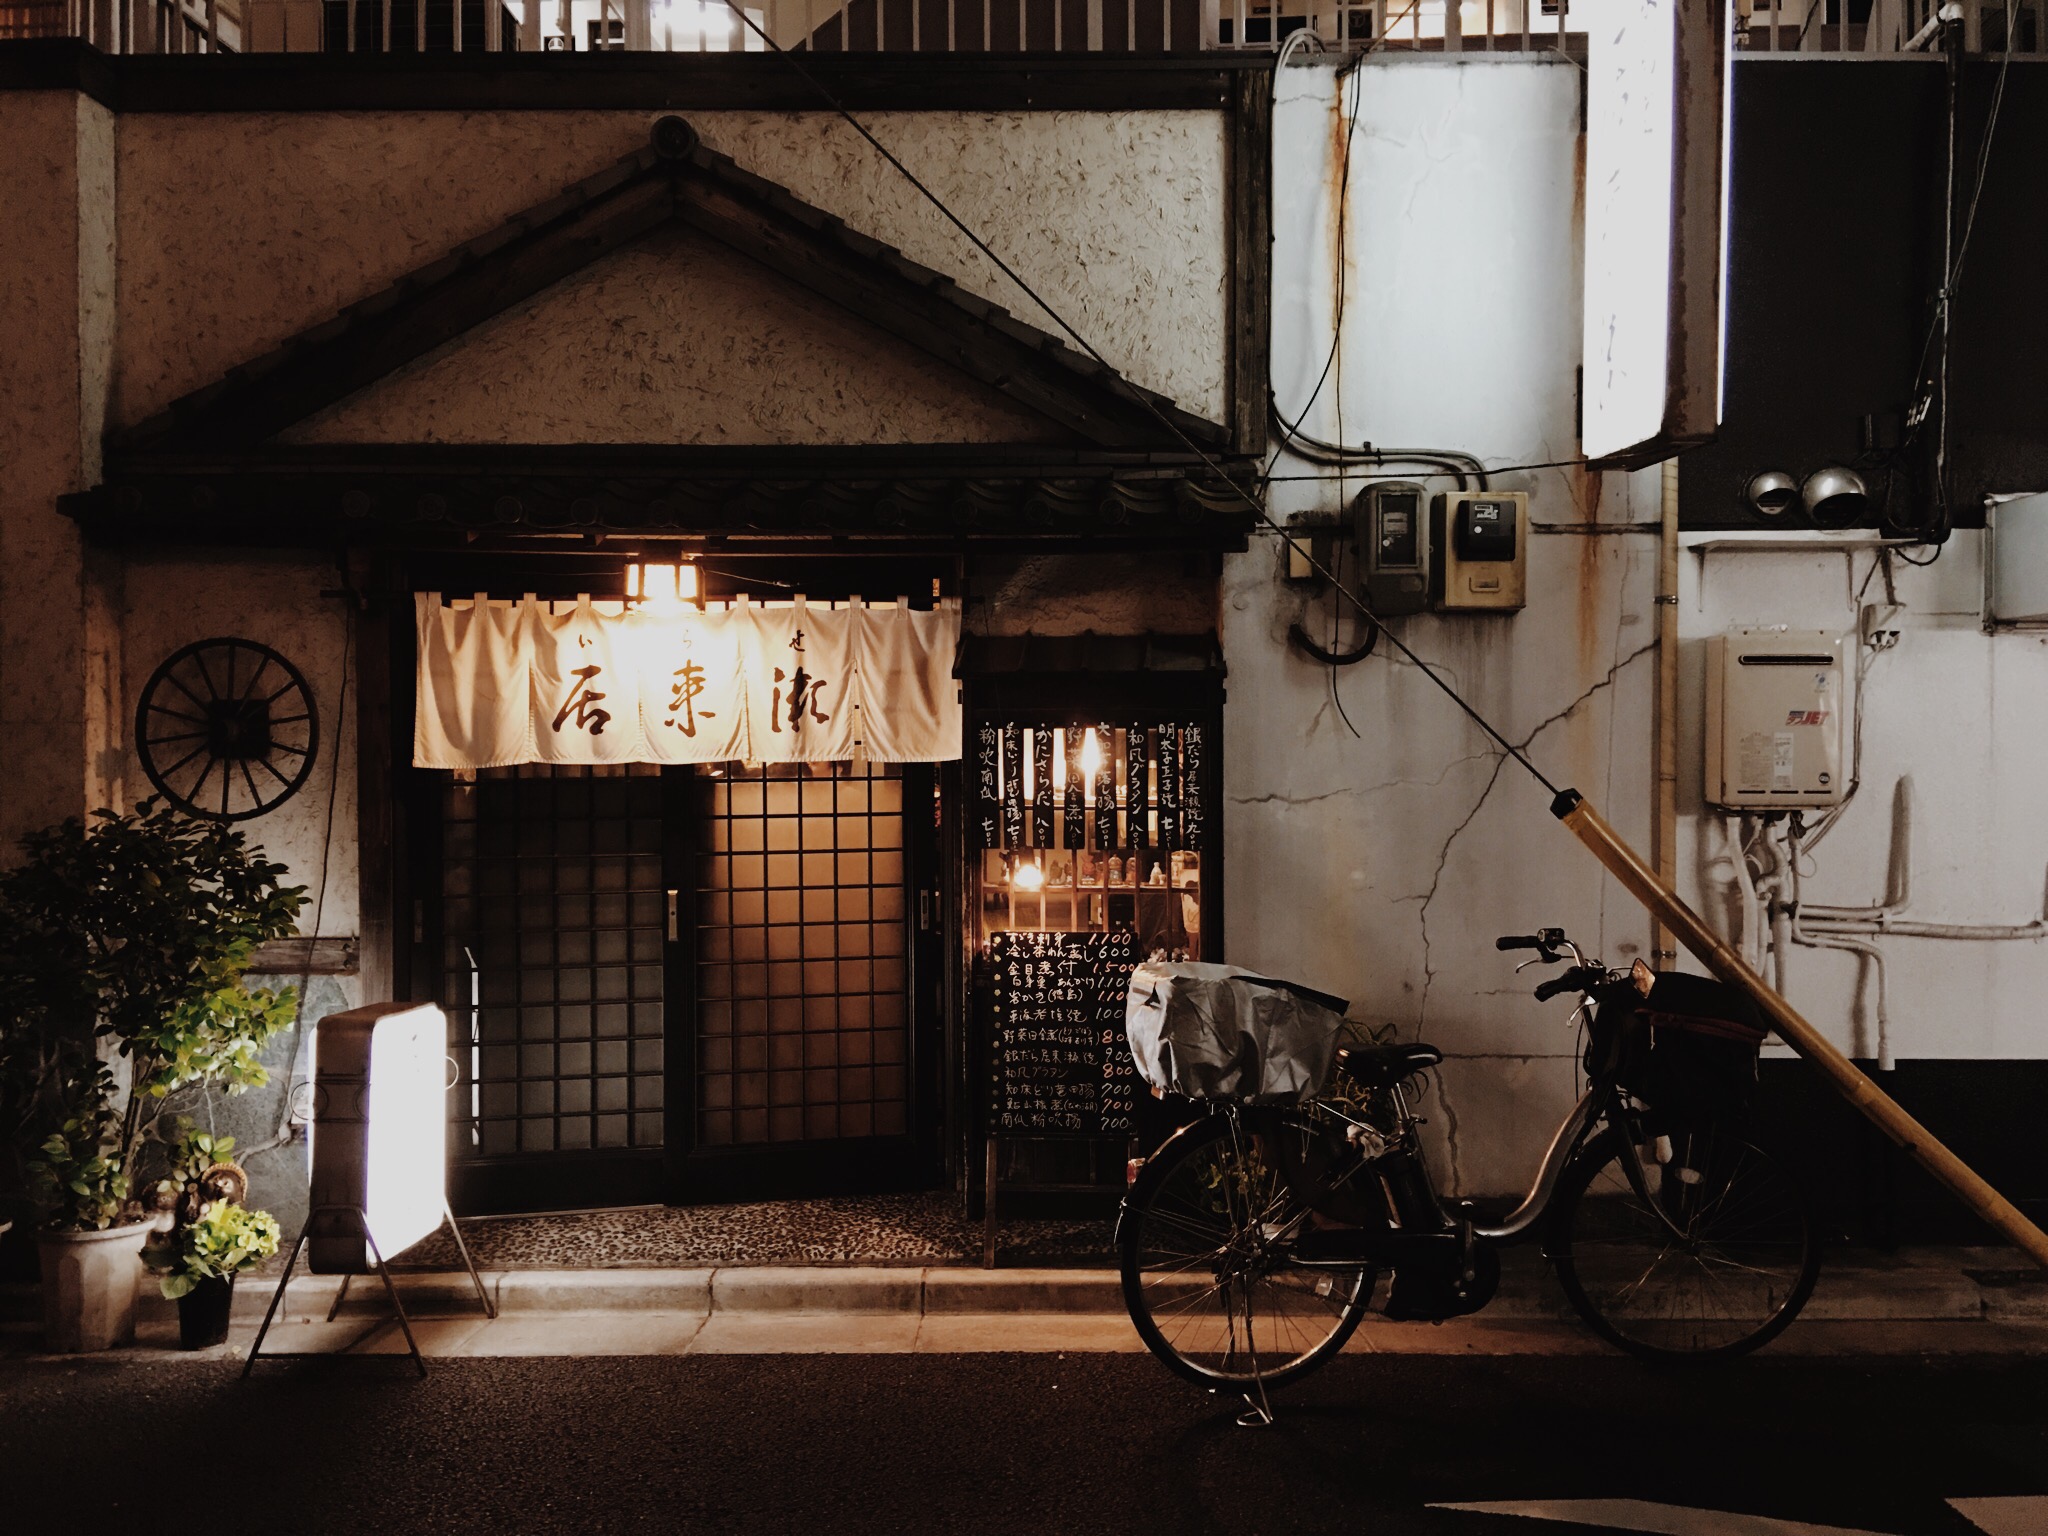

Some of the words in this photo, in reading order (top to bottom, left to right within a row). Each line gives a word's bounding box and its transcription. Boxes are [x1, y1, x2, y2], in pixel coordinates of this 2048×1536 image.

[1034, 729, 1053, 807] かにさらだ
[1099, 945, 1130, 959] 600
[1098, 990, 1128, 1002] 1.10
[1102, 1029, 1129, 1043] 80
[1105, 1047, 1133, 1063] 900
[1102, 1062, 1133, 1079] 800
[1100, 1082, 1131, 1098] 700
[1101, 1098, 1133, 1114] 700
[1100, 1117, 1129, 1131] 700
